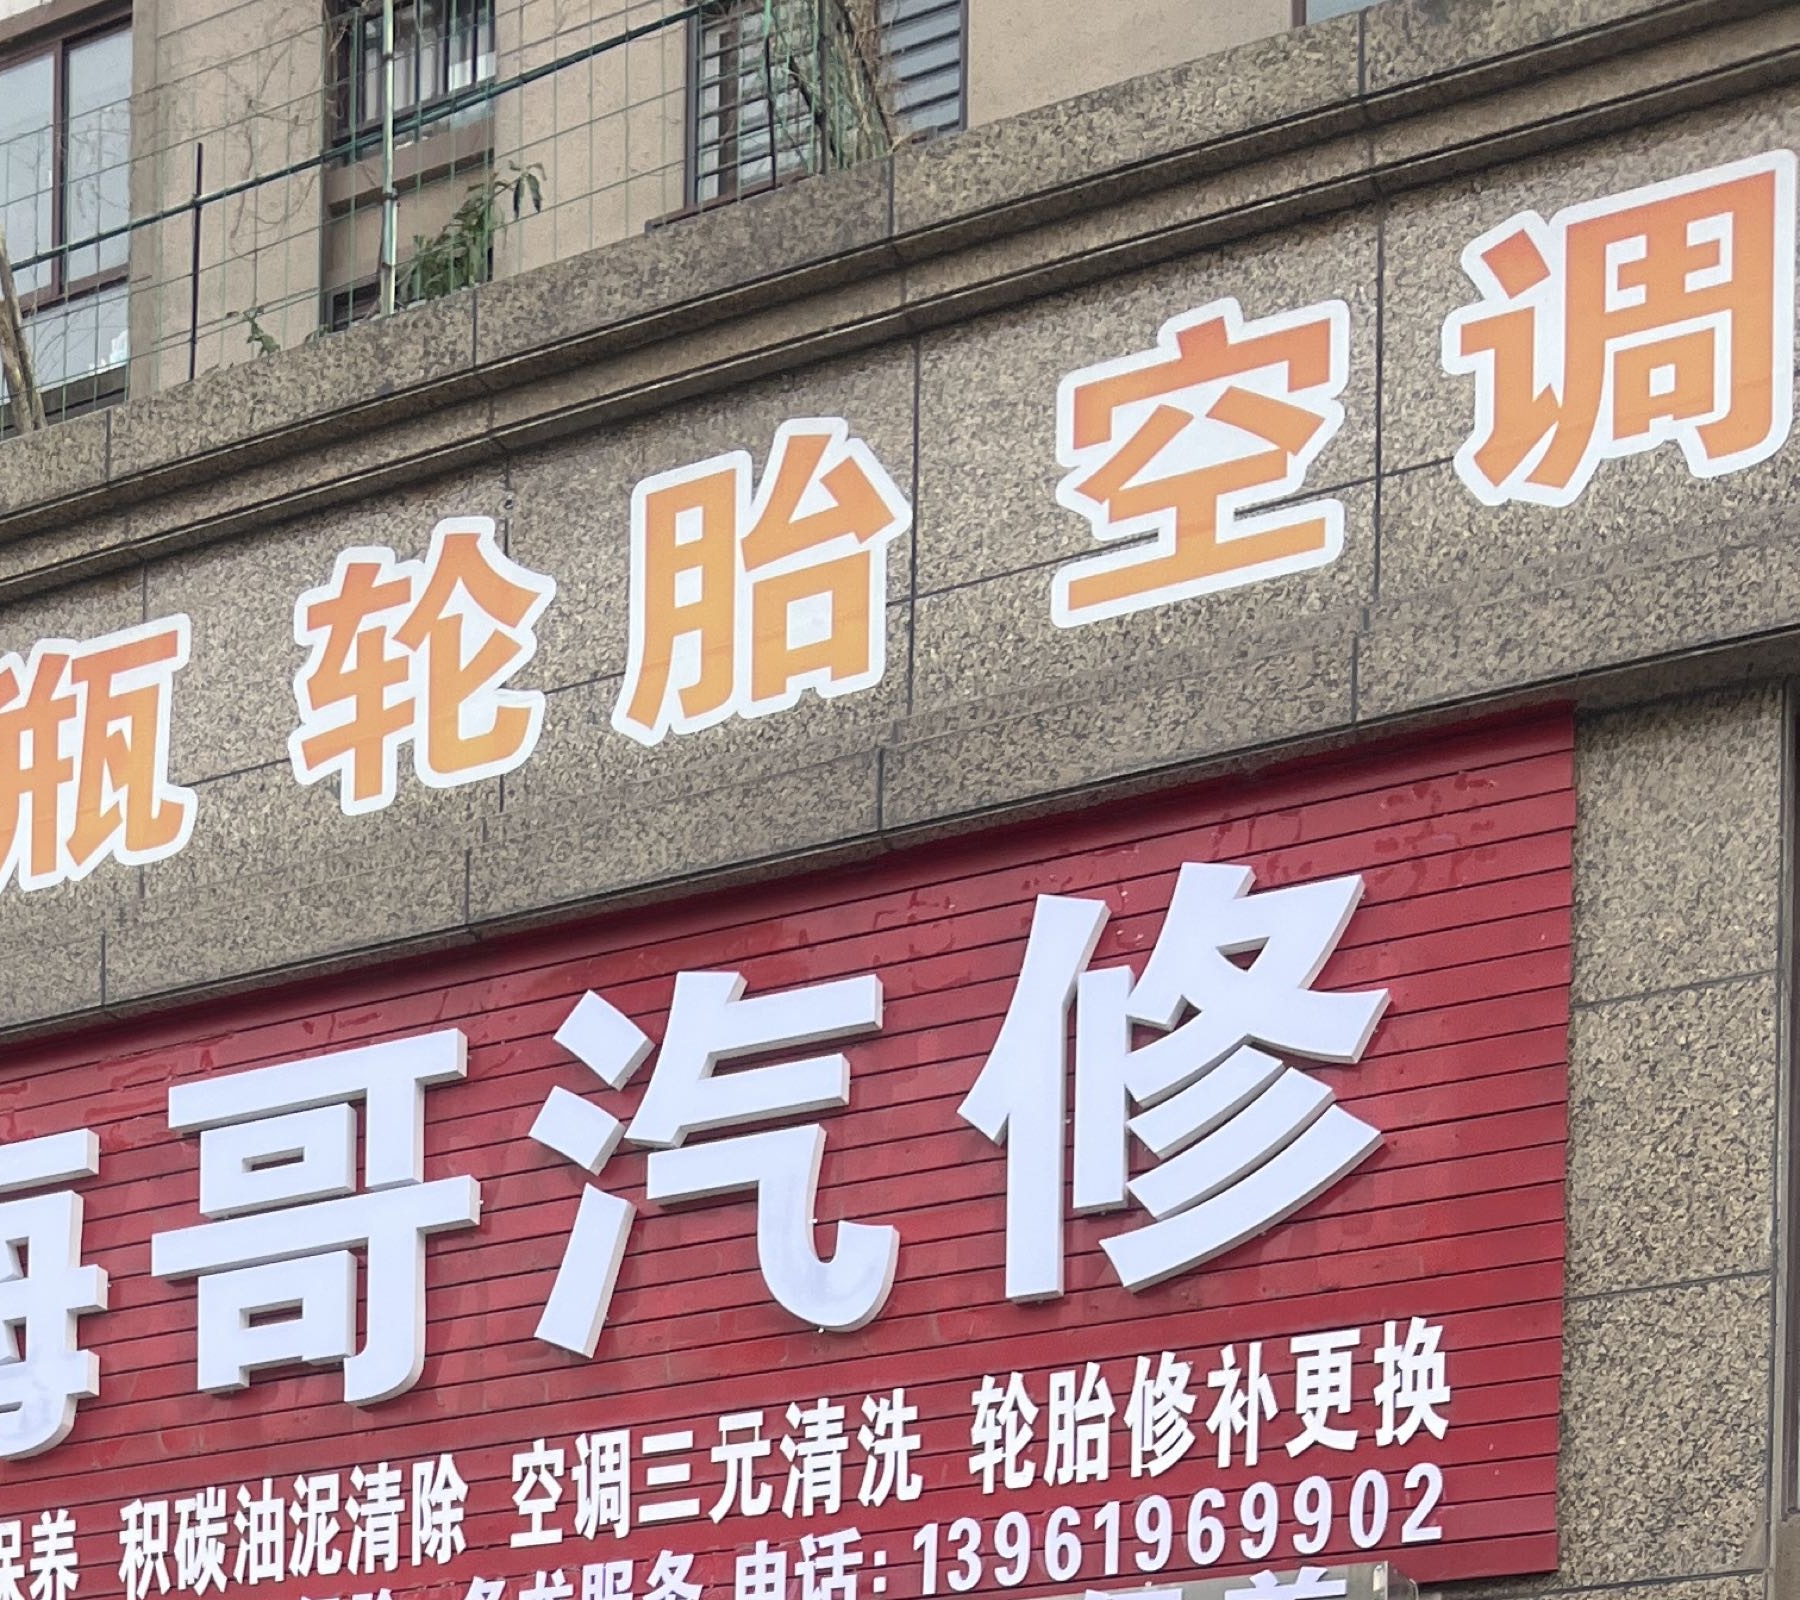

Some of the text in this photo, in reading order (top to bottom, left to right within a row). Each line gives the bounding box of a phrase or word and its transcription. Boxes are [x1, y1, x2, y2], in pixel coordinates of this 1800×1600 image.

[510, 1386, 925, 1549] 空调三元清洗
[969, 1315, 1453, 1496] 轮胎修补更换
